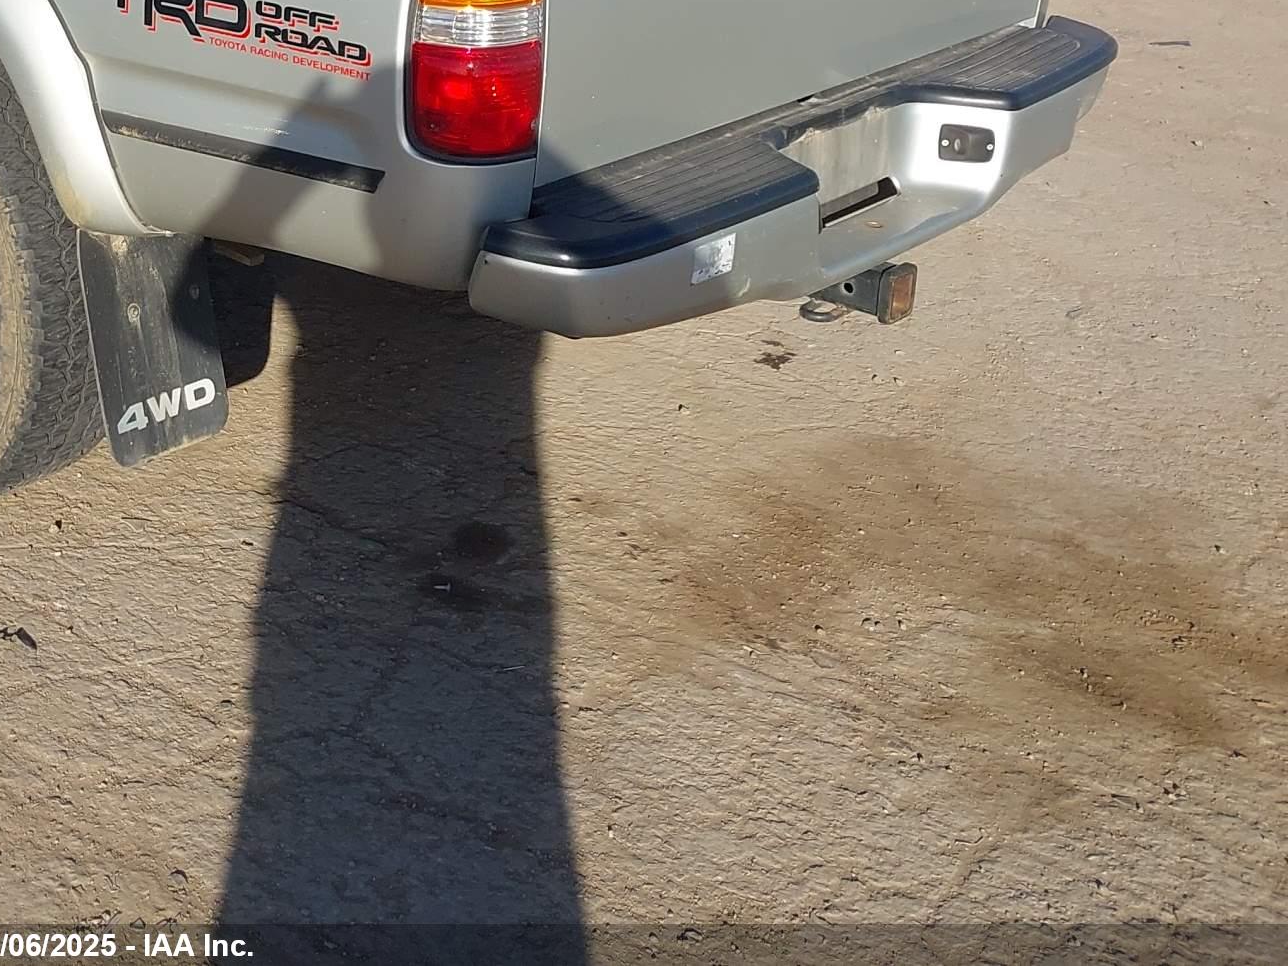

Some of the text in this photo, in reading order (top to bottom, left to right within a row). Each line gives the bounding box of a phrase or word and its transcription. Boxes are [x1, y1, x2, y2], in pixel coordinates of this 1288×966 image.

[254, 0, 340, 33] OFF
[209, 36, 372, 82] TOYOTA RACING DEVELOPMENT
[253, 22, 372, 68] ROAD
[117, 378, 216, 434] 4WD
